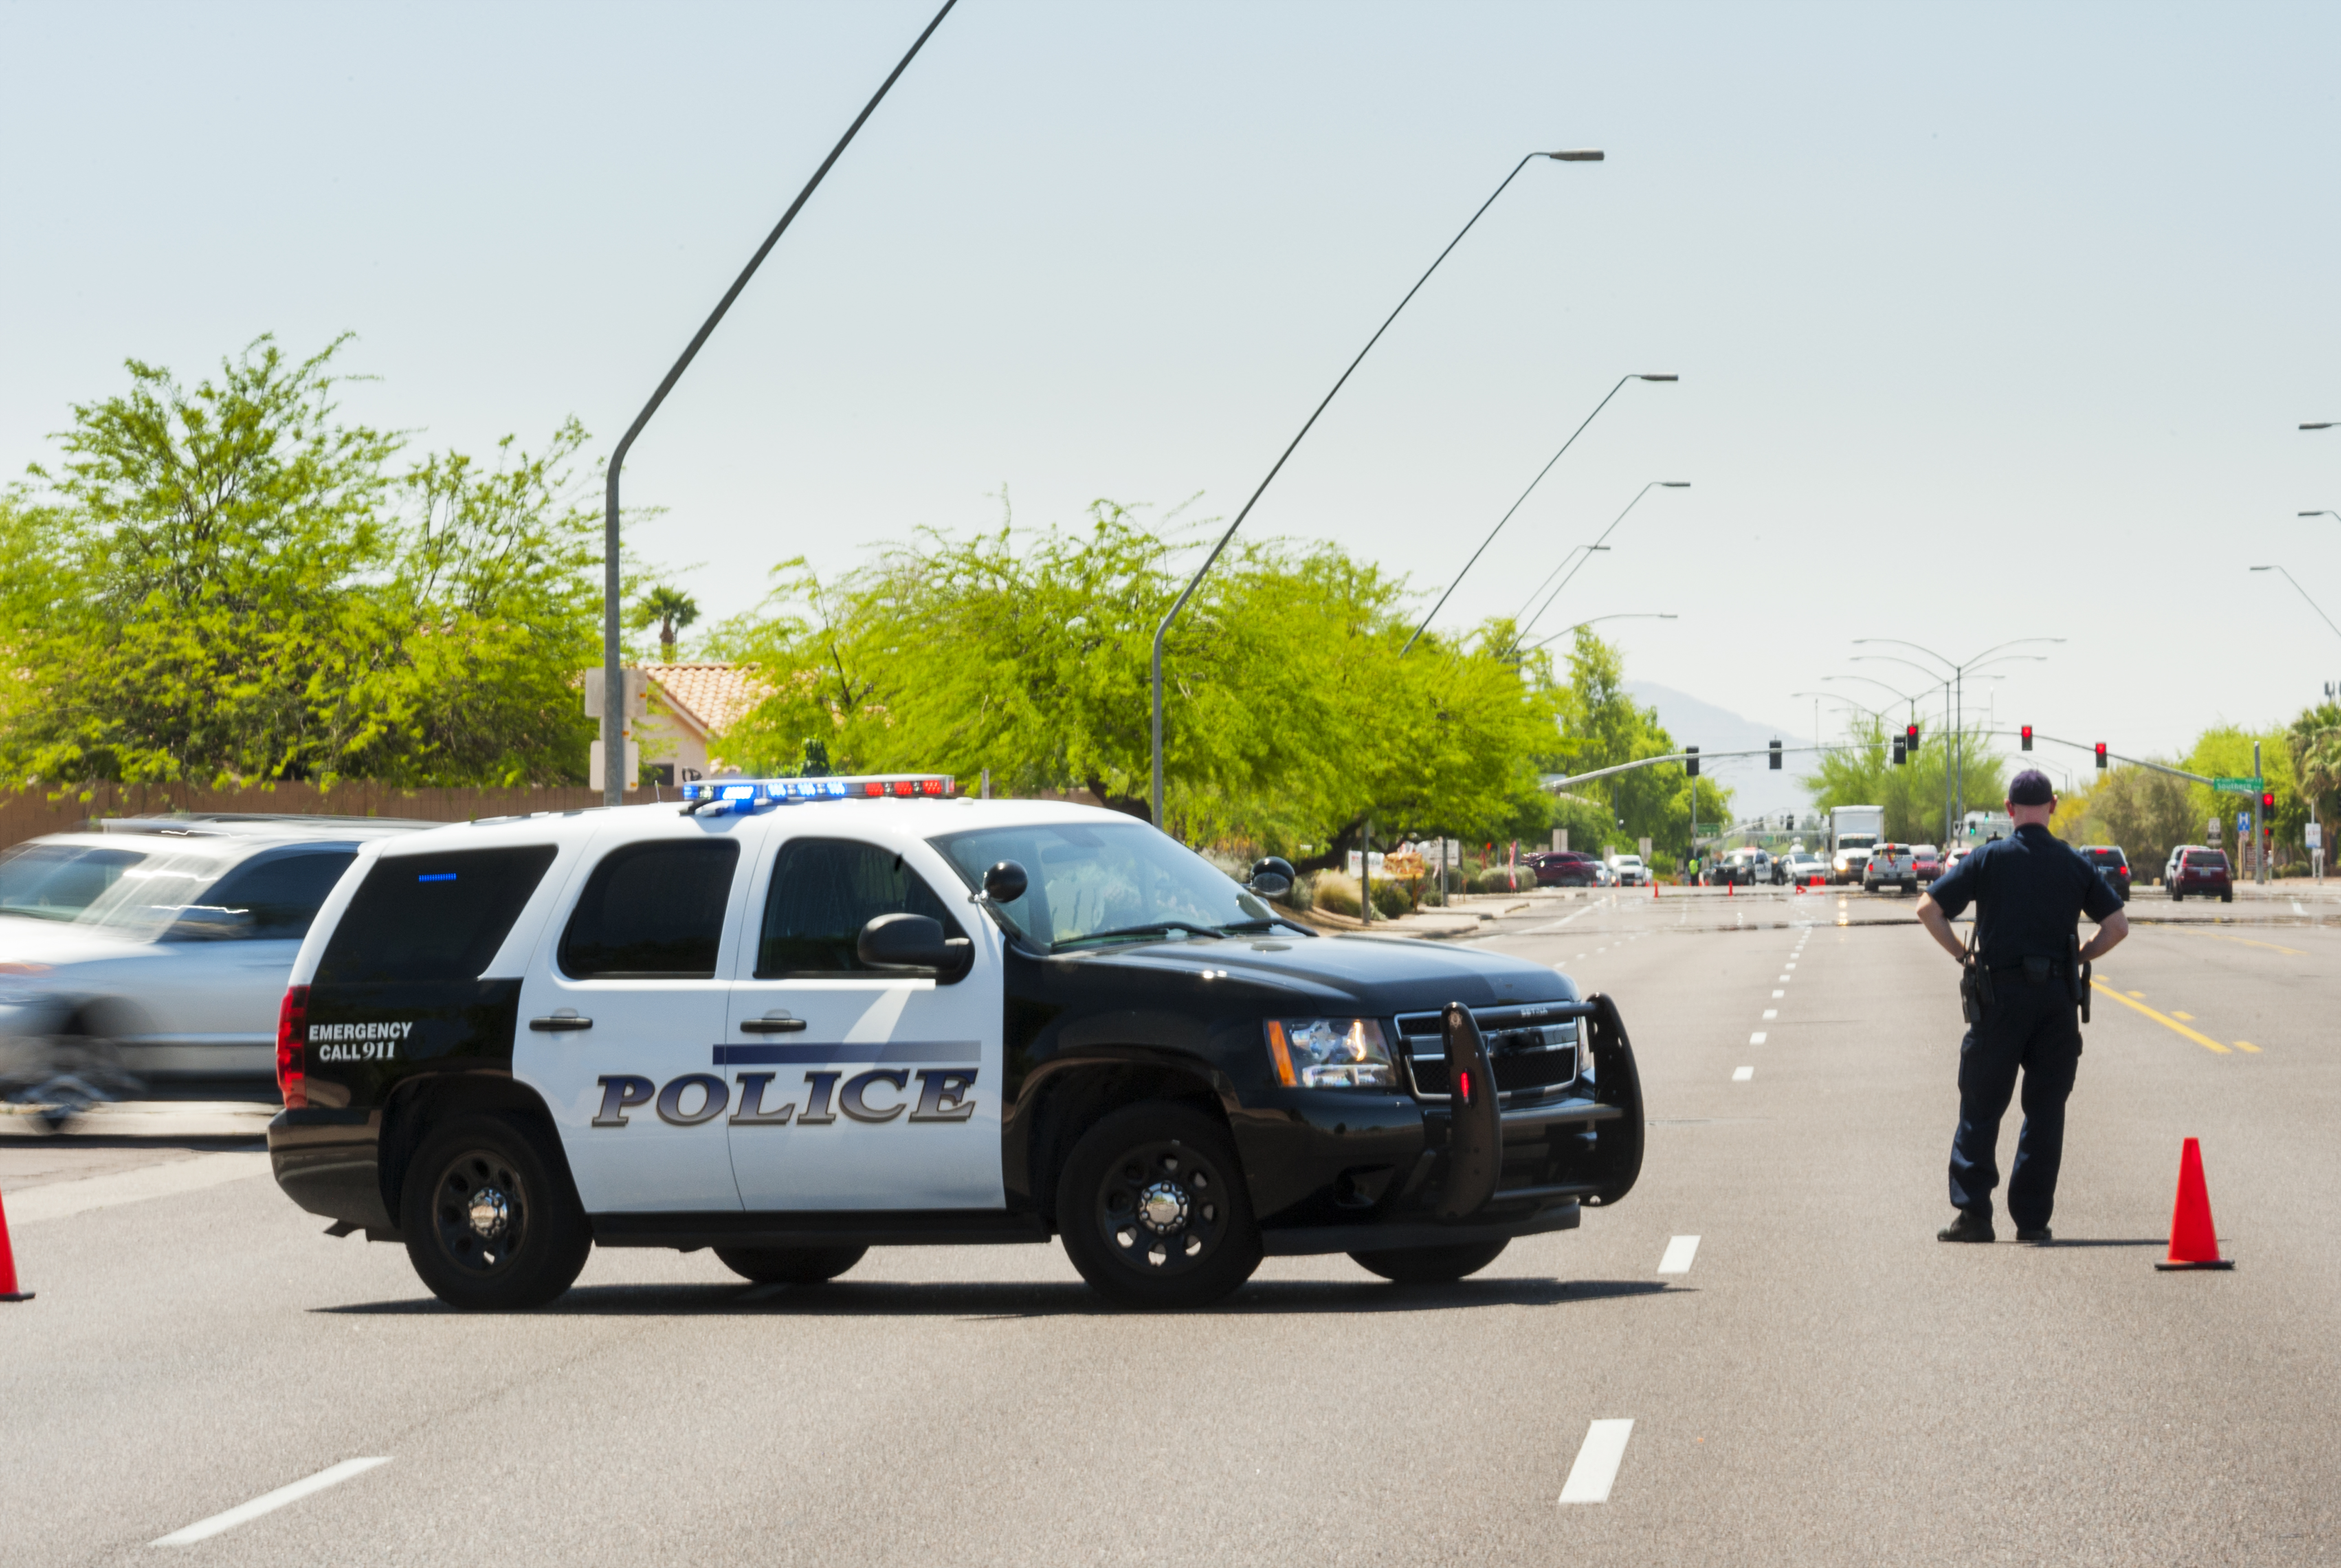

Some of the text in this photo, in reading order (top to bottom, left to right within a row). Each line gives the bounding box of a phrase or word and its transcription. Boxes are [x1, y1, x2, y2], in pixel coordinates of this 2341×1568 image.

[2239, 813, 2249, 824] H
[309, 1021, 412, 1041] EMERGENCY
[319, 1041, 395, 1061] CALL 911
[591, 1068, 979, 1128] POLICE
